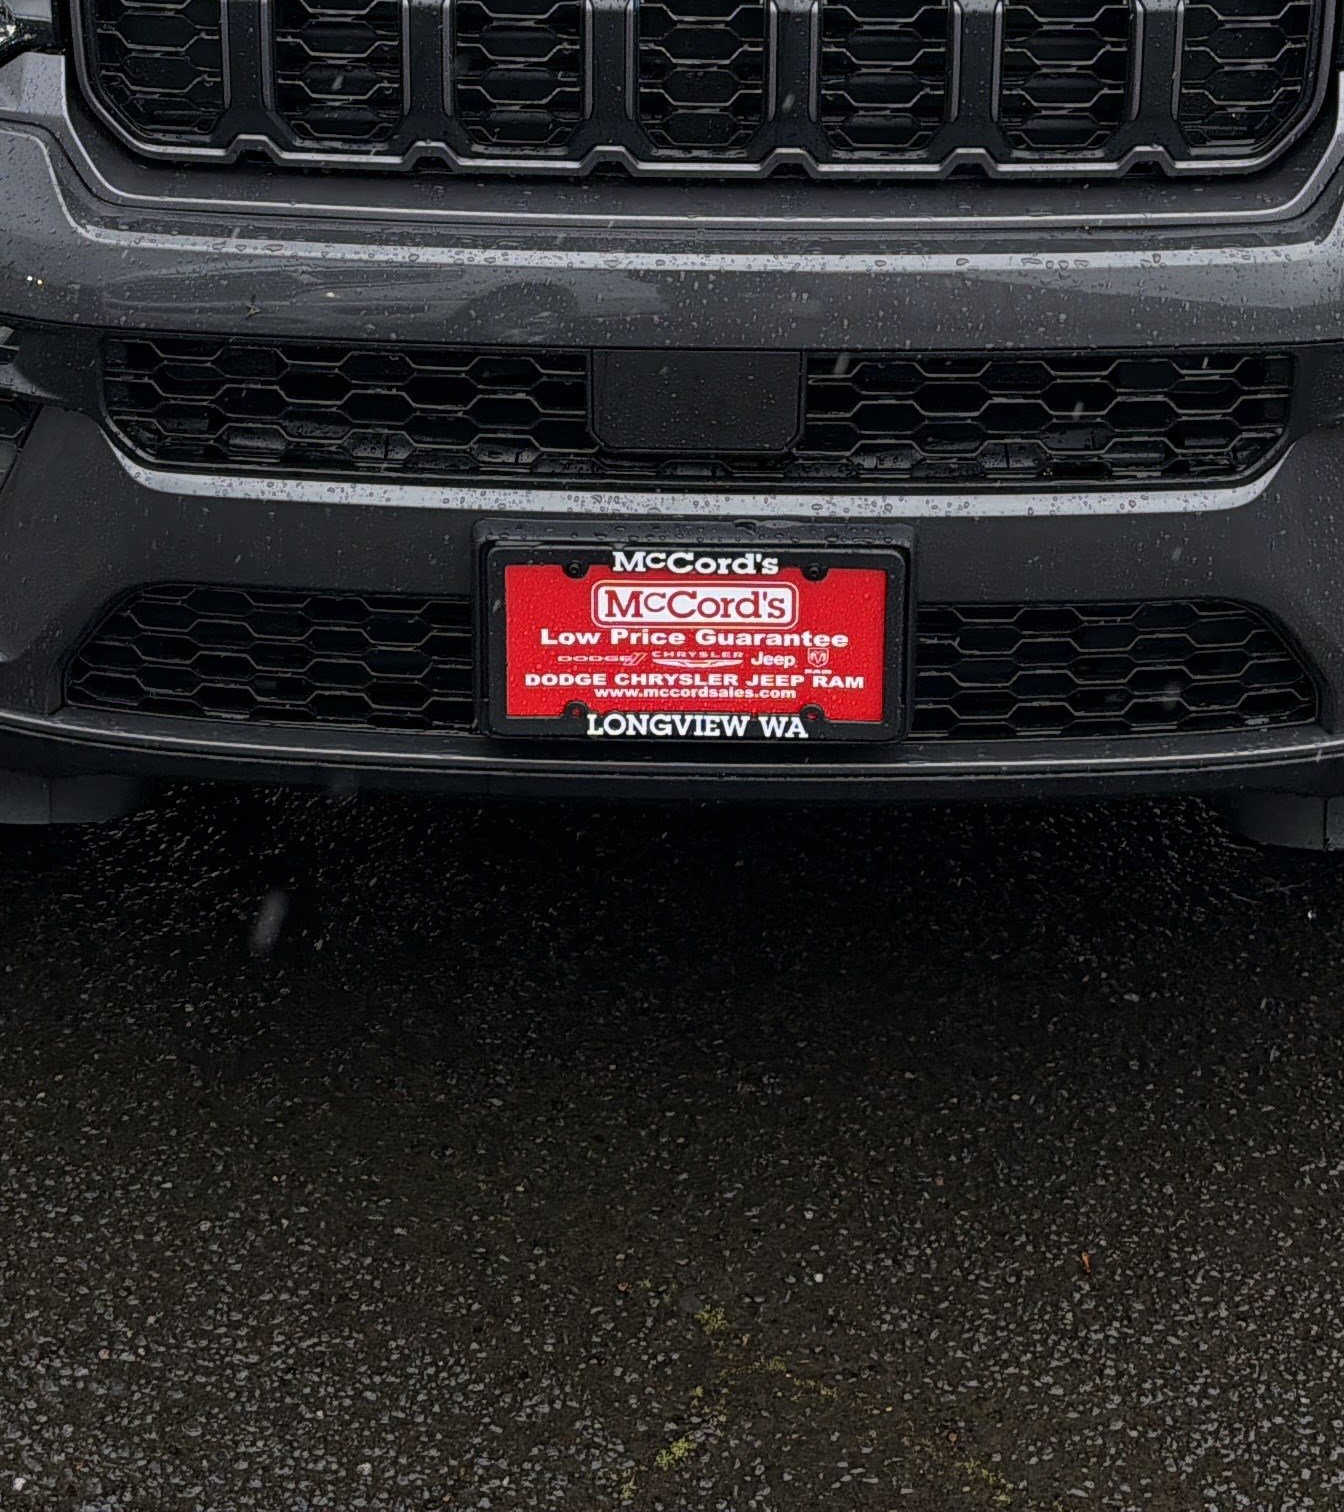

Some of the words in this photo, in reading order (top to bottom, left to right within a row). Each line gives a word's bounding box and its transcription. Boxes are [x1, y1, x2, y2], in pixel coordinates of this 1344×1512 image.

[612, 551, 779, 575] McCord's
[604, 589, 786, 620] McCord's
[540, 628, 601, 645] Low
[610, 628, 686, 645] Price
[695, 629, 849, 648] Guarantee
[651, 650, 744, 658] CHRYSLER
[750, 650, 796, 668] Jeep
[524, 673, 607, 686] DODGE
[614, 673, 739, 686] CHRYSLER
[745, 674, 805, 687] JEEP
[812, 675, 865, 689] RAM
[594, 686, 797, 699] www.mccordsales.com
[586, 713, 751, 737] LONGVIEW
[758, 715, 809, 738] WA
